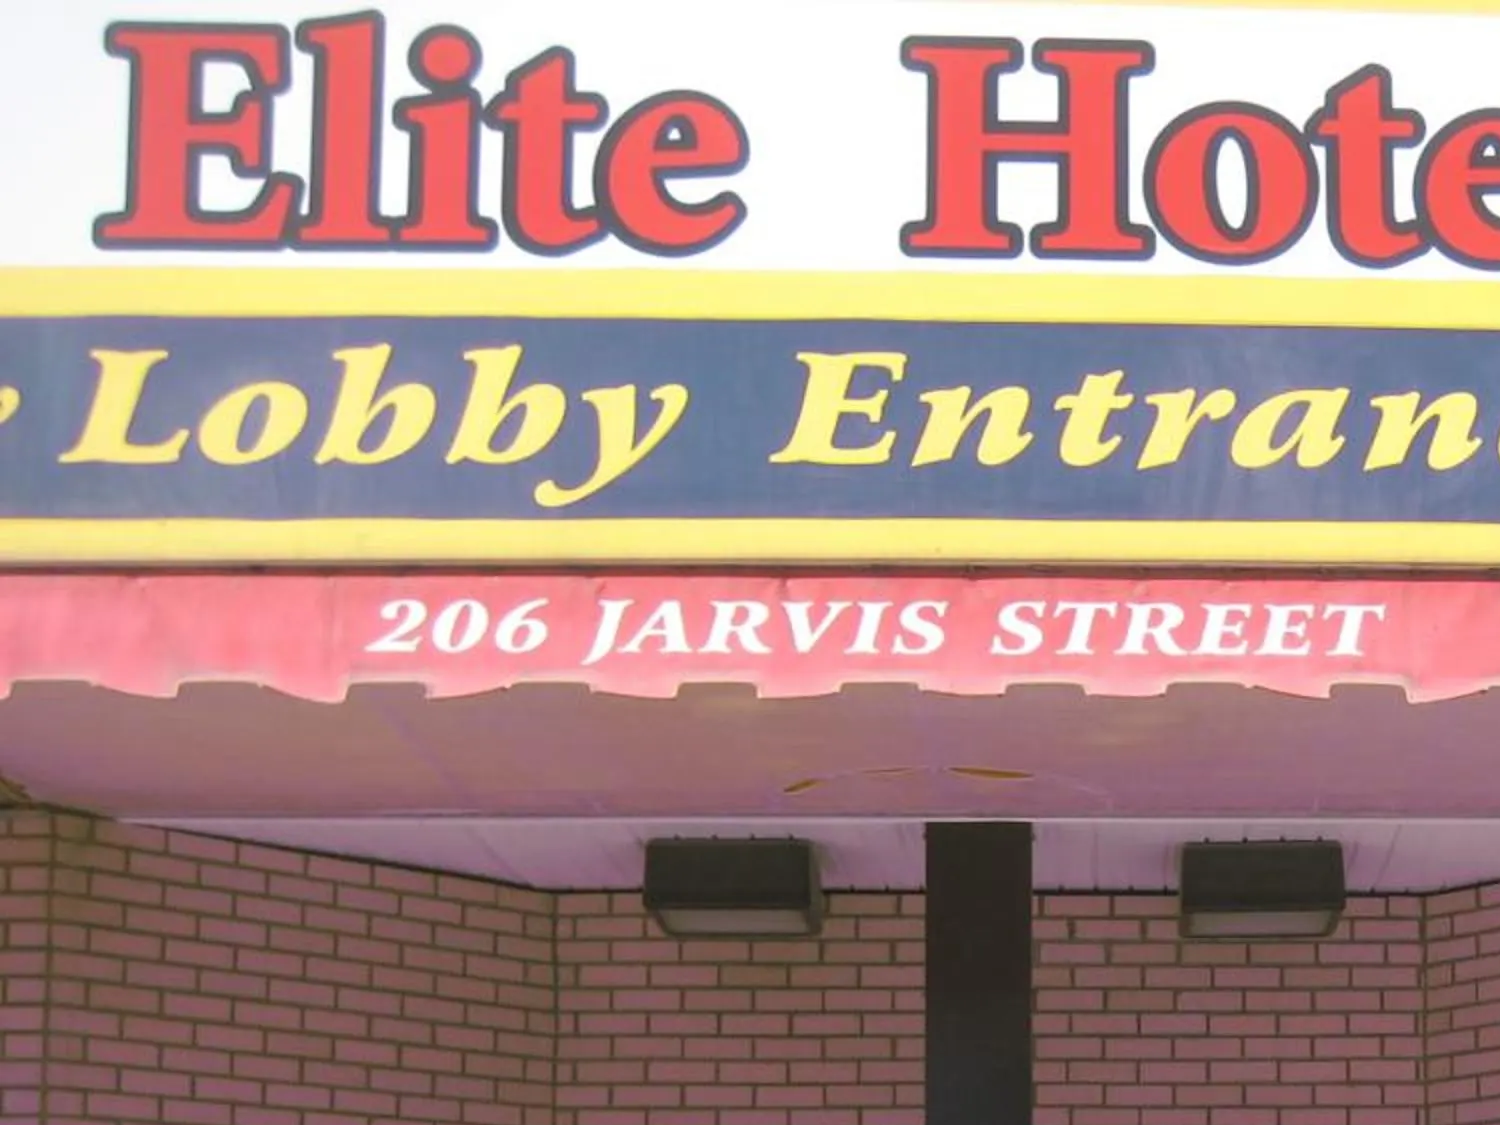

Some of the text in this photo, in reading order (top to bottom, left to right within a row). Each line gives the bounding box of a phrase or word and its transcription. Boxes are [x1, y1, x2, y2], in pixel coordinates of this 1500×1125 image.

[92, 8, 750, 256] Elite
[58, 343, 689, 509] Lobby
[365, 598, 1387, 667] 206 JARVIS STREET
